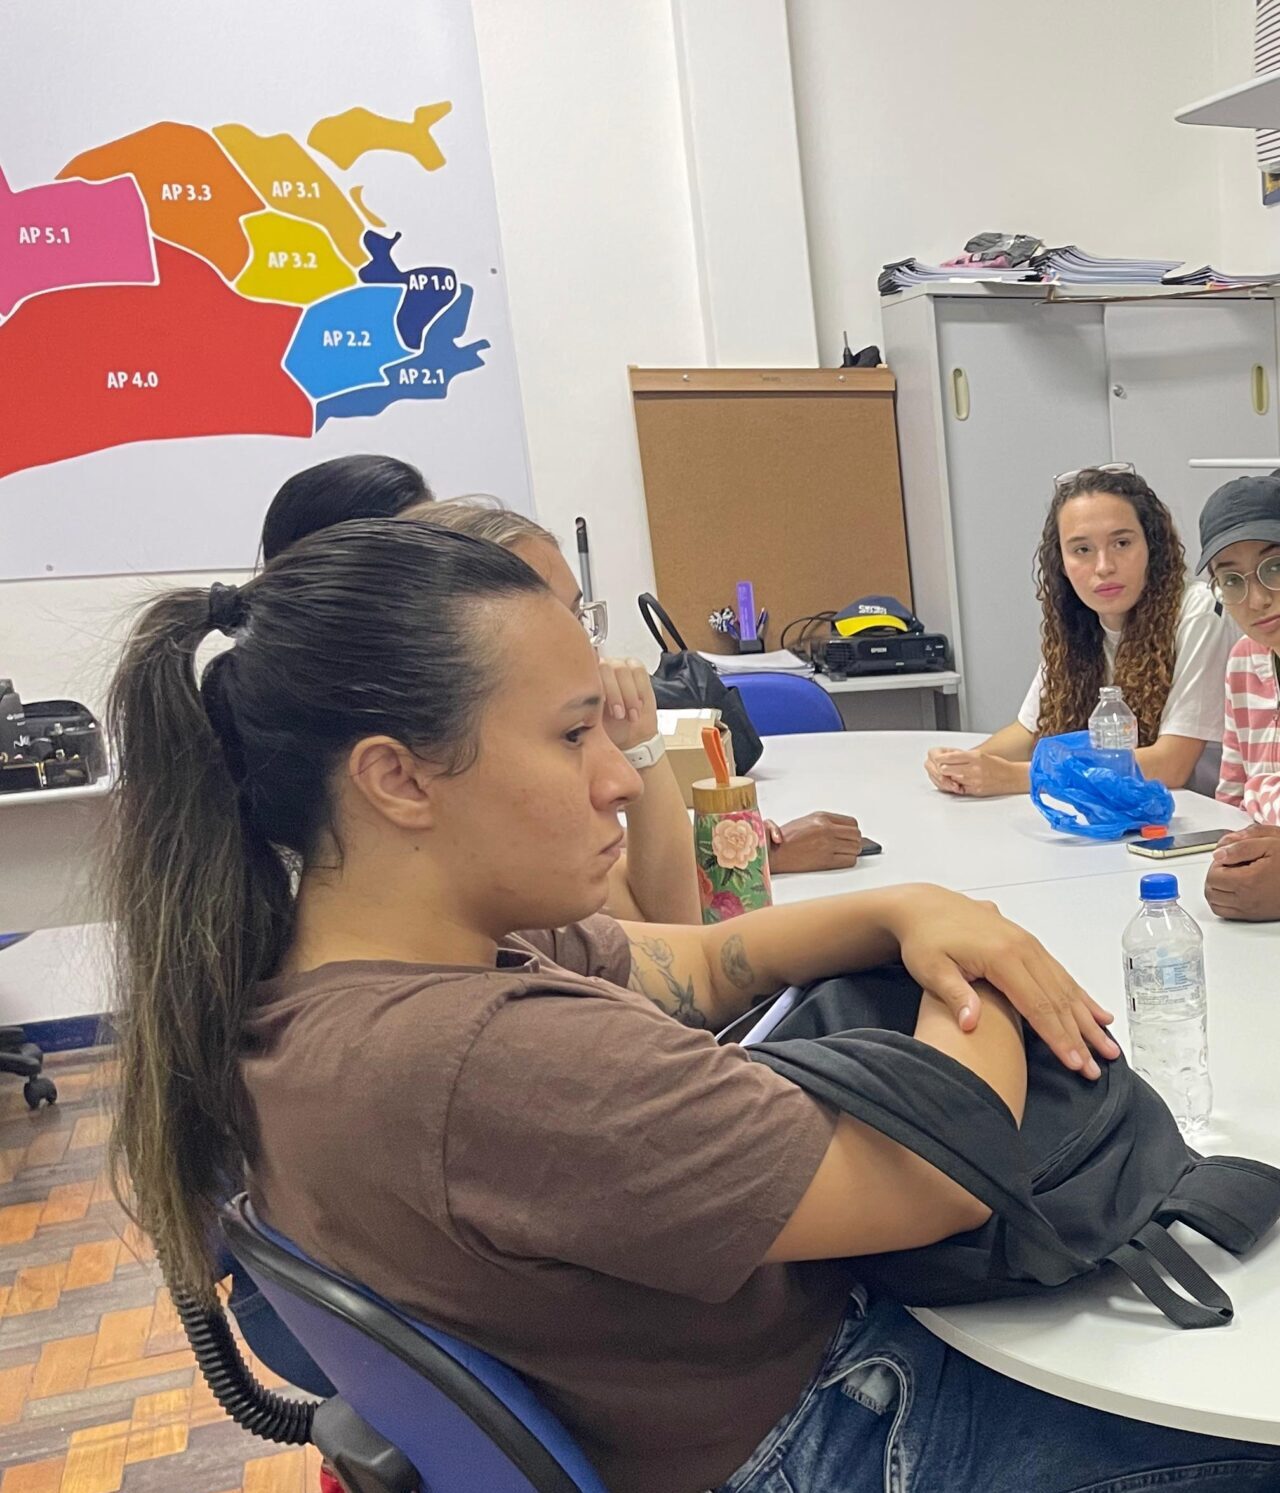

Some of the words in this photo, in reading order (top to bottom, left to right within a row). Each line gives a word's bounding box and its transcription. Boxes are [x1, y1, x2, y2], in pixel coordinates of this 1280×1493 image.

[161, 183, 182, 201] AP
[186, 184, 212, 201] 3.3
[272, 180, 292, 198] AP
[296, 181, 321, 199] 3.1
[19, 226, 41, 244] AP
[45, 227, 70, 244] 5.1
[268, 251, 289, 268] AP
[292, 252, 317, 269] 3.2
[409, 274, 429, 291] AP
[430, 275, 455, 291] 1.0
[323, 330, 343, 347] AP
[346, 330, 371, 347] 2.2
[107, 371, 129, 389] AP
[132, 371, 159, 388] 4.0
[399, 368, 419, 385] AP
[421, 368, 445, 385] 2.1
